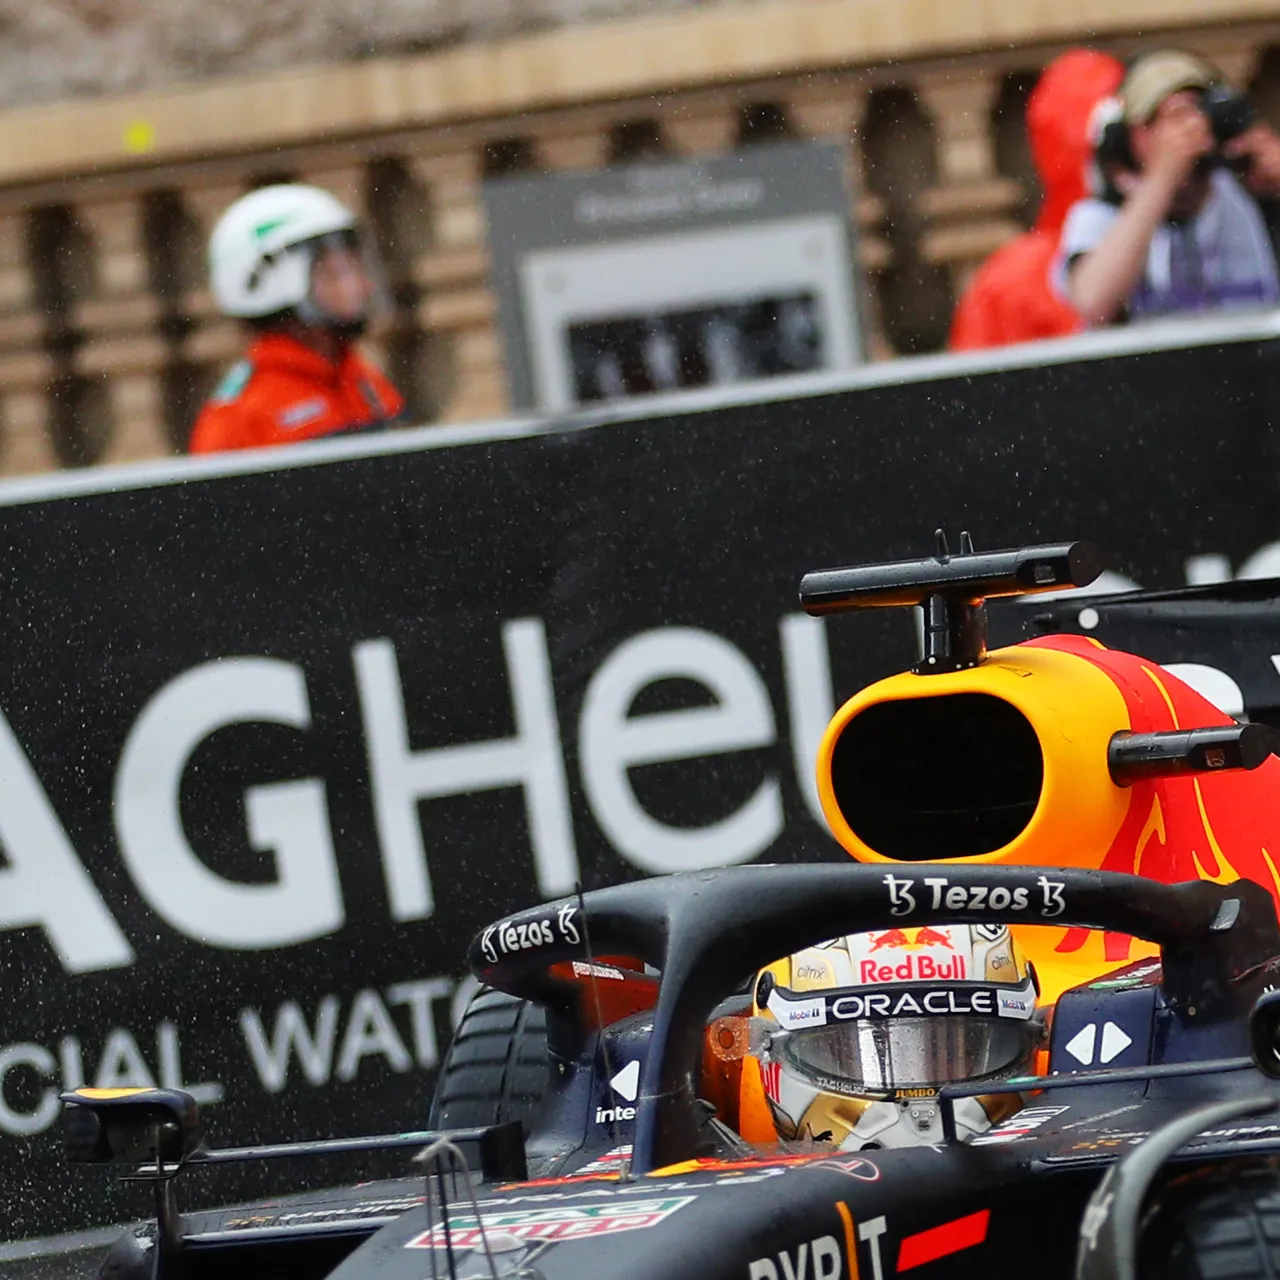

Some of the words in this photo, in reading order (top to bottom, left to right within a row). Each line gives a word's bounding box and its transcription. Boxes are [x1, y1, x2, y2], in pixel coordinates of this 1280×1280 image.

[924, 878, 1029, 912] Tezos
[498, 919, 555, 954] Tezos
[860, 956, 914, 984] Red
[917, 955, 966, 980] Bull
[832, 991, 993, 1020] ORACLE
[238, 972, 480, 1095] WAT
[894, 1087, 936, 1099] JUMBO
[595, 1106, 638, 1124] inte
